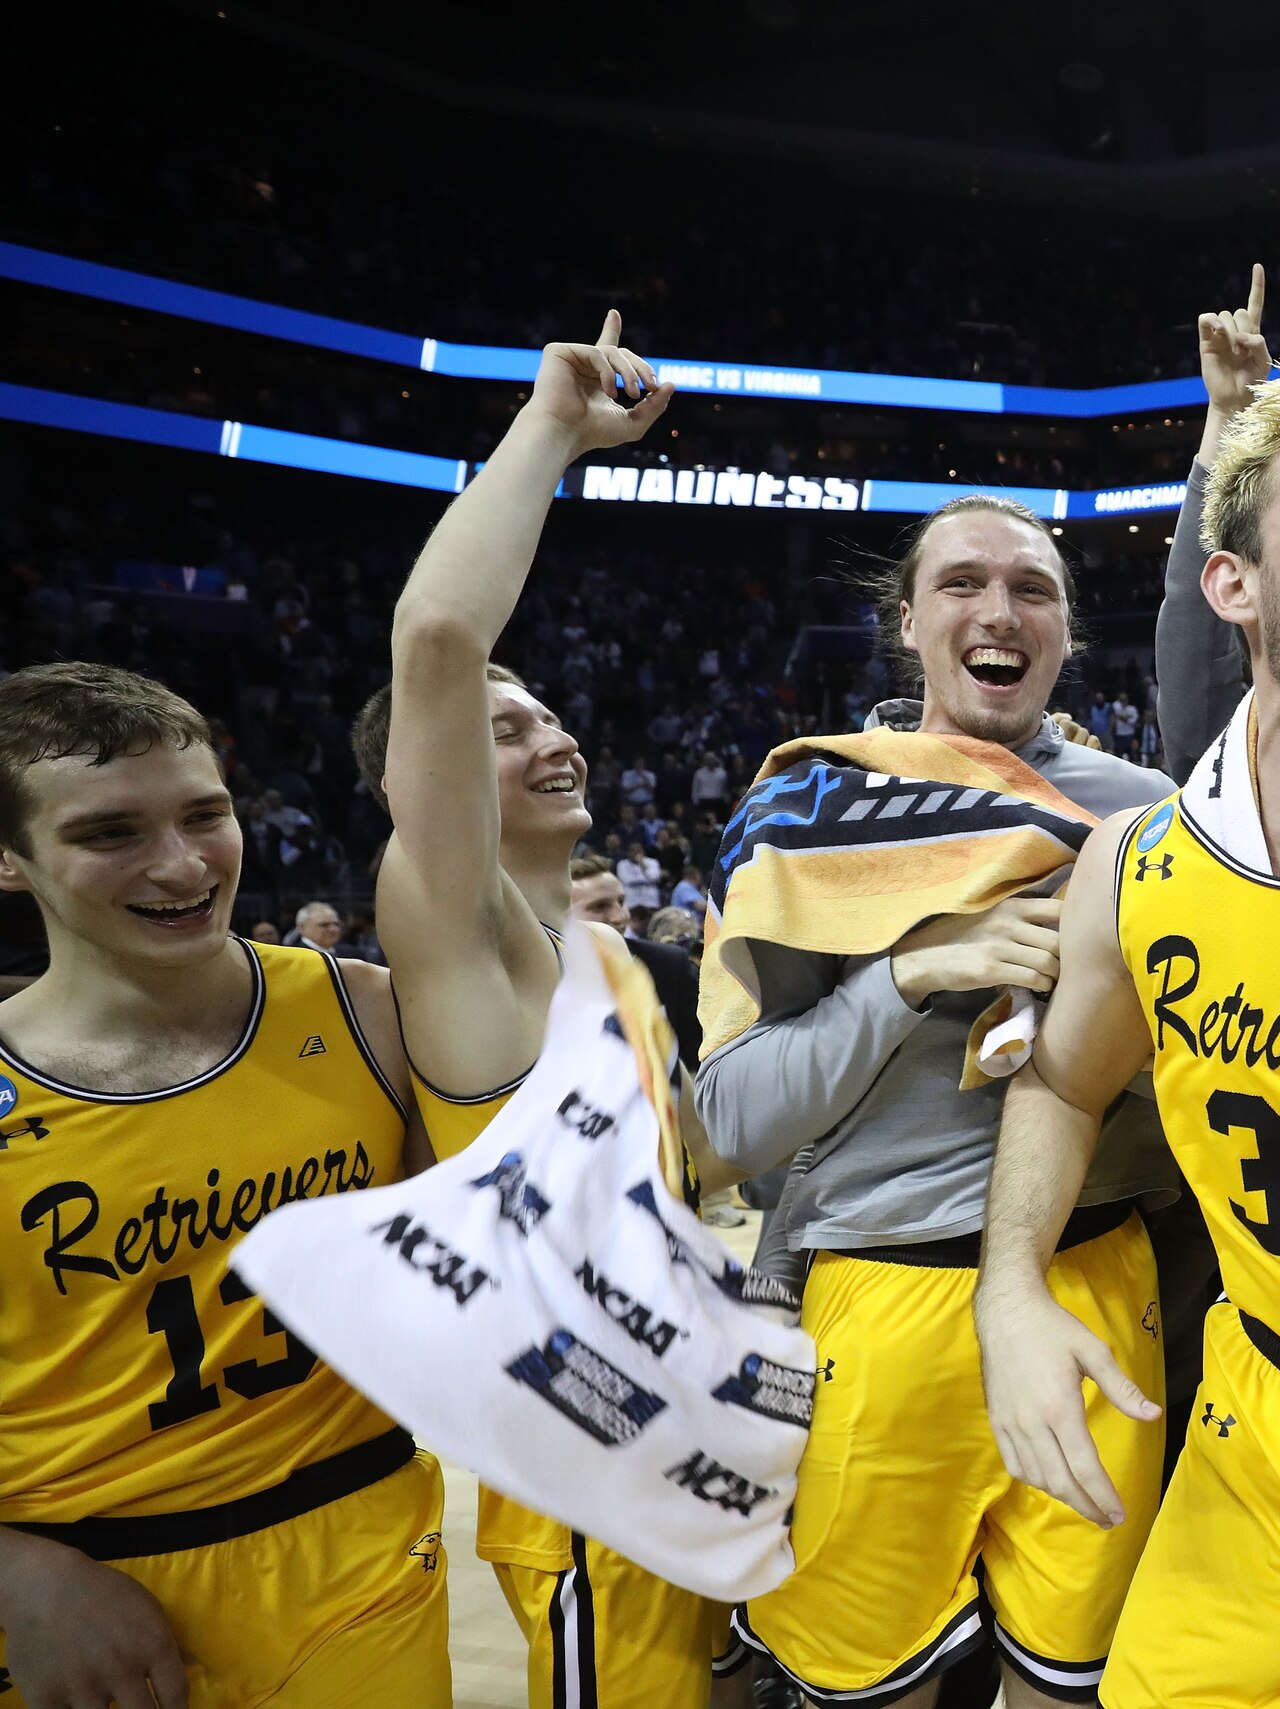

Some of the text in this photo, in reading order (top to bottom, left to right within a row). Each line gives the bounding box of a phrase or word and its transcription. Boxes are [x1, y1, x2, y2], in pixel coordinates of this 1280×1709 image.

[716, 368, 741, 390] VS
[743, 370, 821, 396] VIRGINIA
[21, 1141, 375, 1295] Retrievers
[574, 1257, 678, 1357] NCAA
[662, 1449, 769, 1518] NCAA
